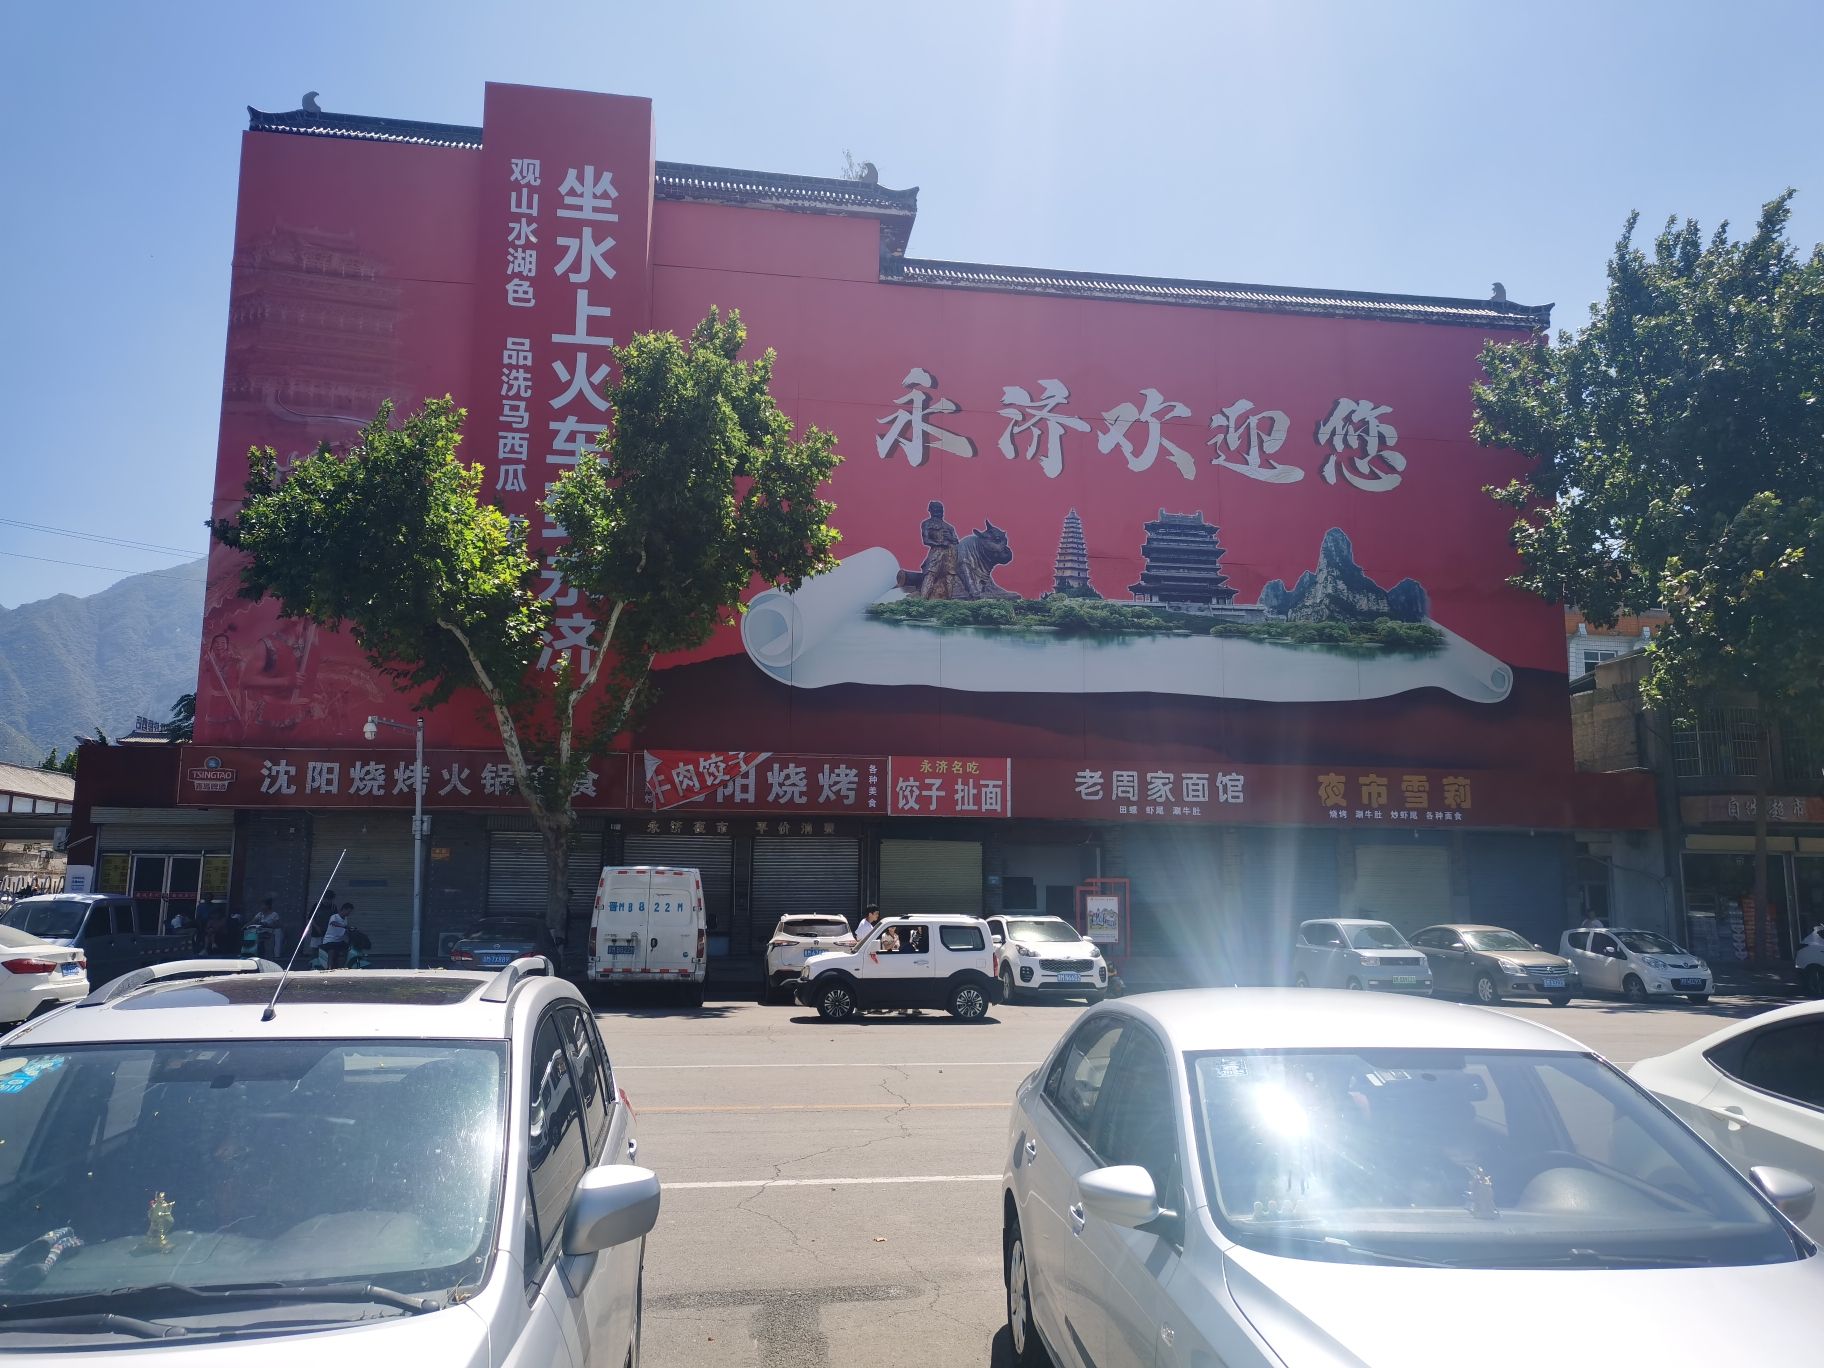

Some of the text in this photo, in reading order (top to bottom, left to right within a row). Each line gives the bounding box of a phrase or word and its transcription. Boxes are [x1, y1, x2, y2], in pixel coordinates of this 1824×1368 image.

[505, 157, 542, 309] 观山水湖色
[495, 336, 533, 494] 品洗马西瓜
[538, 164, 620, 676] 坐水上火车永济
[876, 367, 1408, 493] 永济欢迎您
[193, 770, 232, 779] TSINGTAO
[259, 759, 600, 798] 沈阳烧烤火锅食
[692, 762, 859, 805] 阳烧烤
[867, 764, 878, 808] 各种美食
[920, 759, 980, 775] 永济名吃
[1074, 768, 1245, 803] 老周家面馆
[896, 776, 1003, 813] 饺子 扯面
[1317, 772, 1472, 808] 夜市雪莉
